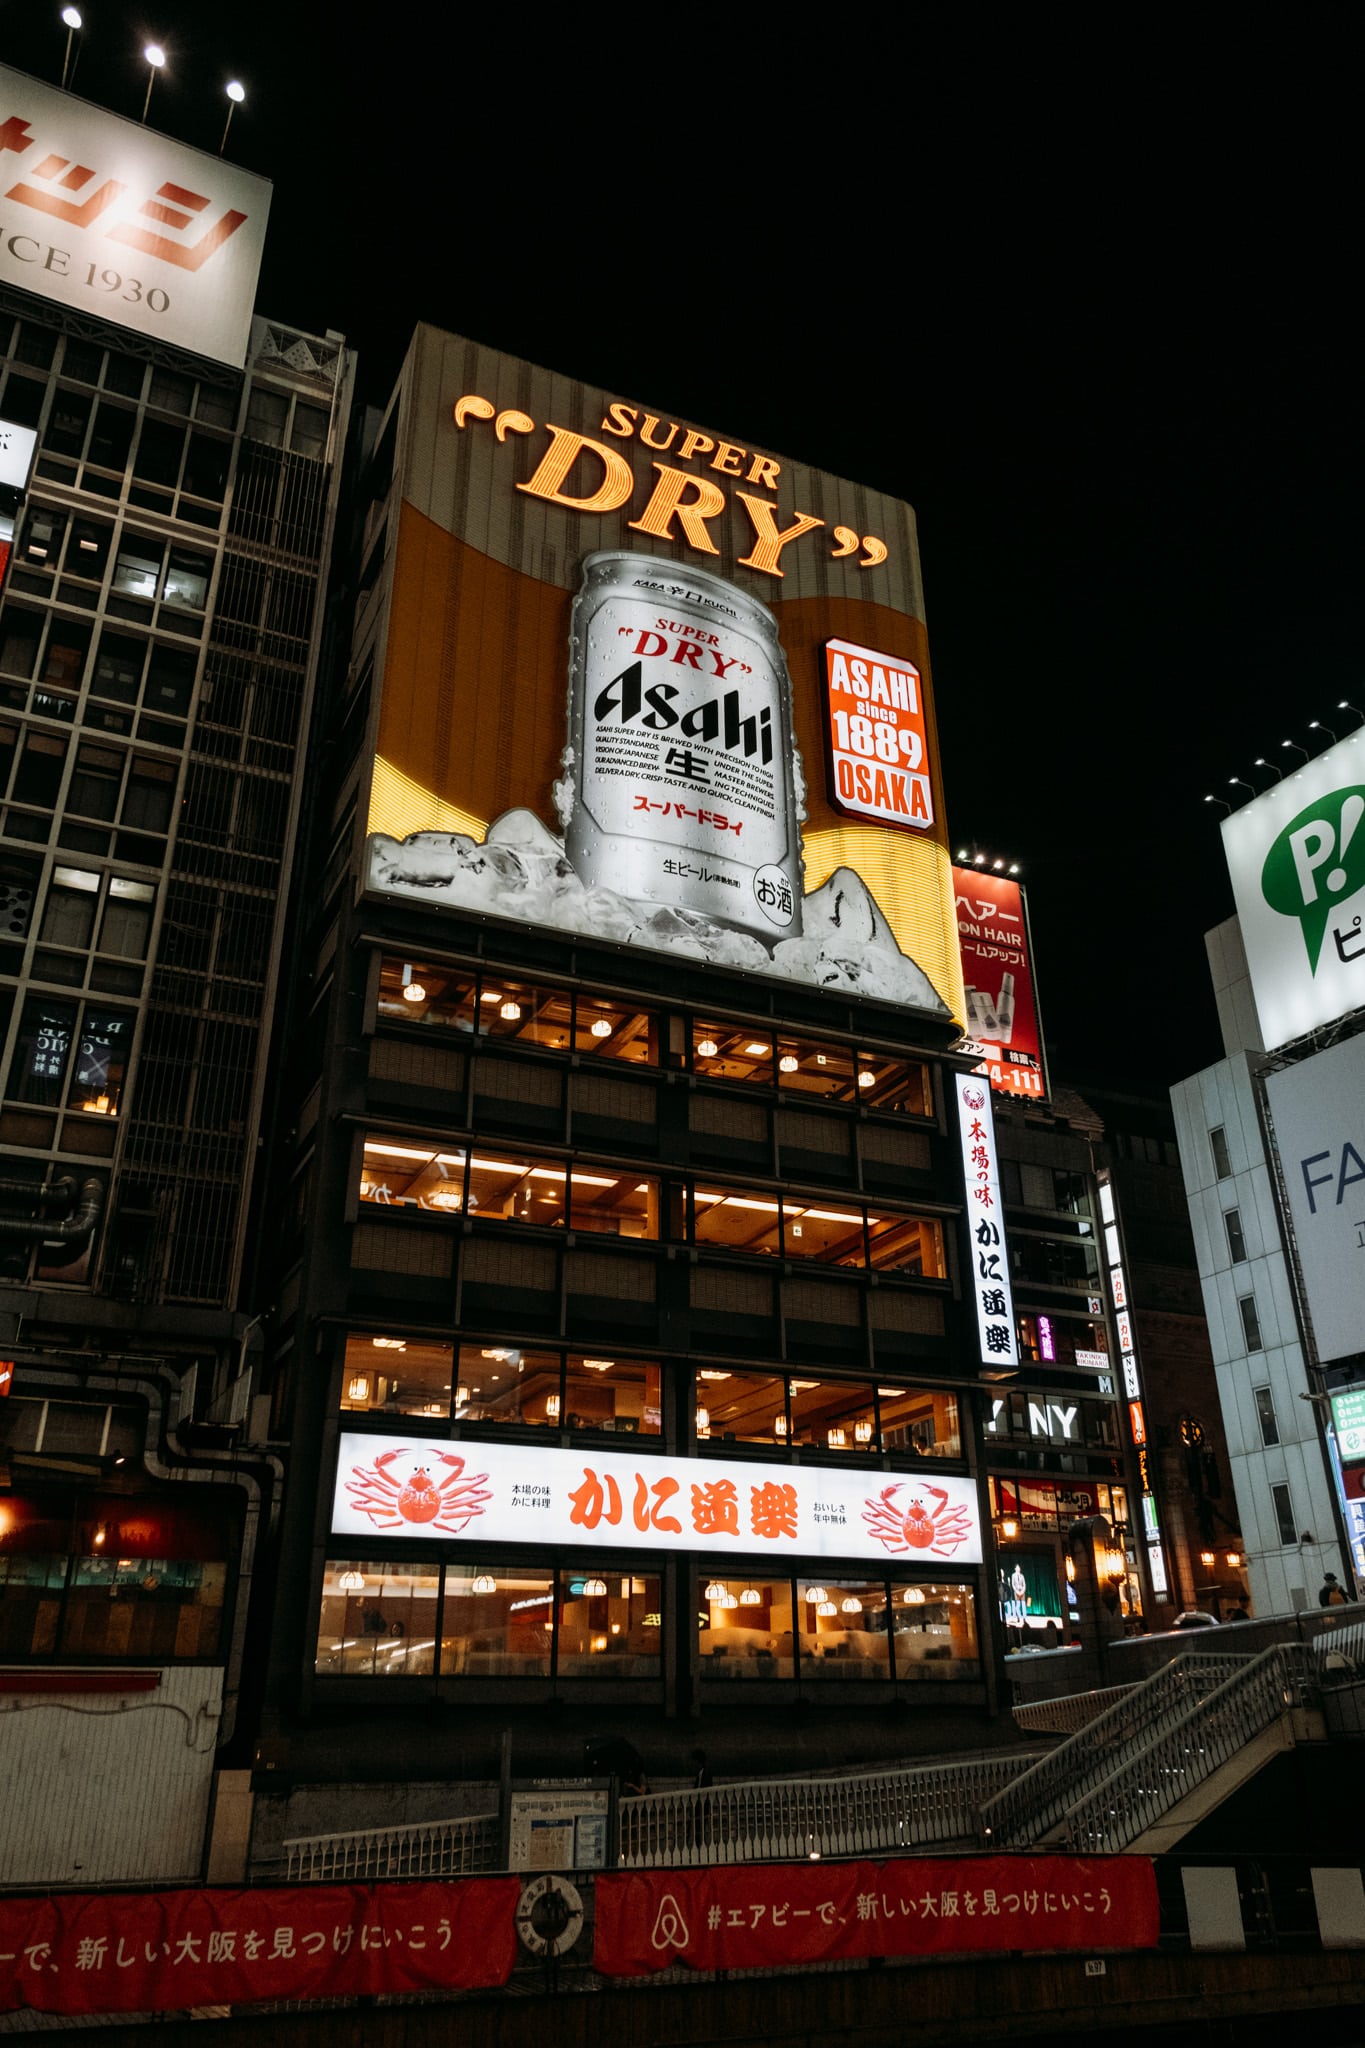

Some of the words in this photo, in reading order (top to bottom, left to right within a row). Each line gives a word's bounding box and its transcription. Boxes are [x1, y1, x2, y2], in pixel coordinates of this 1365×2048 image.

[0, 228, 70, 276] CE
[85, 262, 170, 313] 1930
[601, 403, 781, 490] SUPER
[634, 579, 665, 591] KARA
[703, 599, 737, 616] KUCHI
[656, 618, 719, 648] SUPER
[832, 654, 918, 715] ASAHI
[594, 660, 773, 766] Asahi
[856, 701, 898, 725] since
[614, 727, 635, 735] SUPER
[661, 735, 692, 748] BREWED
[694, 743, 714, 755] WITH
[715, 751, 751, 769] PRECISION
[751, 765, 760, 773] TO
[760, 769, 774, 780] HIGH
[623, 749, 659, 760] JAPANESE
[833, 709, 923, 769] 1889
[595, 736, 619, 744] QUALITY
[714, 761, 740, 774] UNDER
[741, 769, 755, 780] THE
[665, 748, 710, 785] 生
[595, 767, 619, 775] DELIVER
[625, 771, 640, 779] DRY,
[641, 772, 663, 781] CRISP
[663, 777, 687, 788] TASTE
[688, 784, 707, 793] AND
[707, 789, 733, 803] QUICK,
[734, 798, 757, 811] CLEAN
[606, 757, 638, 767] ADVANCED
[714, 781, 730, 790] ING
[731, 785, 775, 809] TECHNIQUES
[715, 771, 746, 785] MASTER
[838, 759, 929, 820] OSAKA
[633, 796, 743, 836] スーパードライ
[757, 878, 792, 915] お酒
[956, 896, 1020, 923] ヘアー
[984, 927, 1022, 946] HAIR
[1010, 1051, 1029, 1066] 検索
[968, 1118, 993, 1208] 本場の味
[1028, 1402, 1078, 1438] NY
[511, 1484, 551, 1497] 本場の味
[511, 1496, 551, 1509] かに料理
[813, 1501, 847, 1514] おいしさ
[813, 1512, 848, 1525] 年中無休
